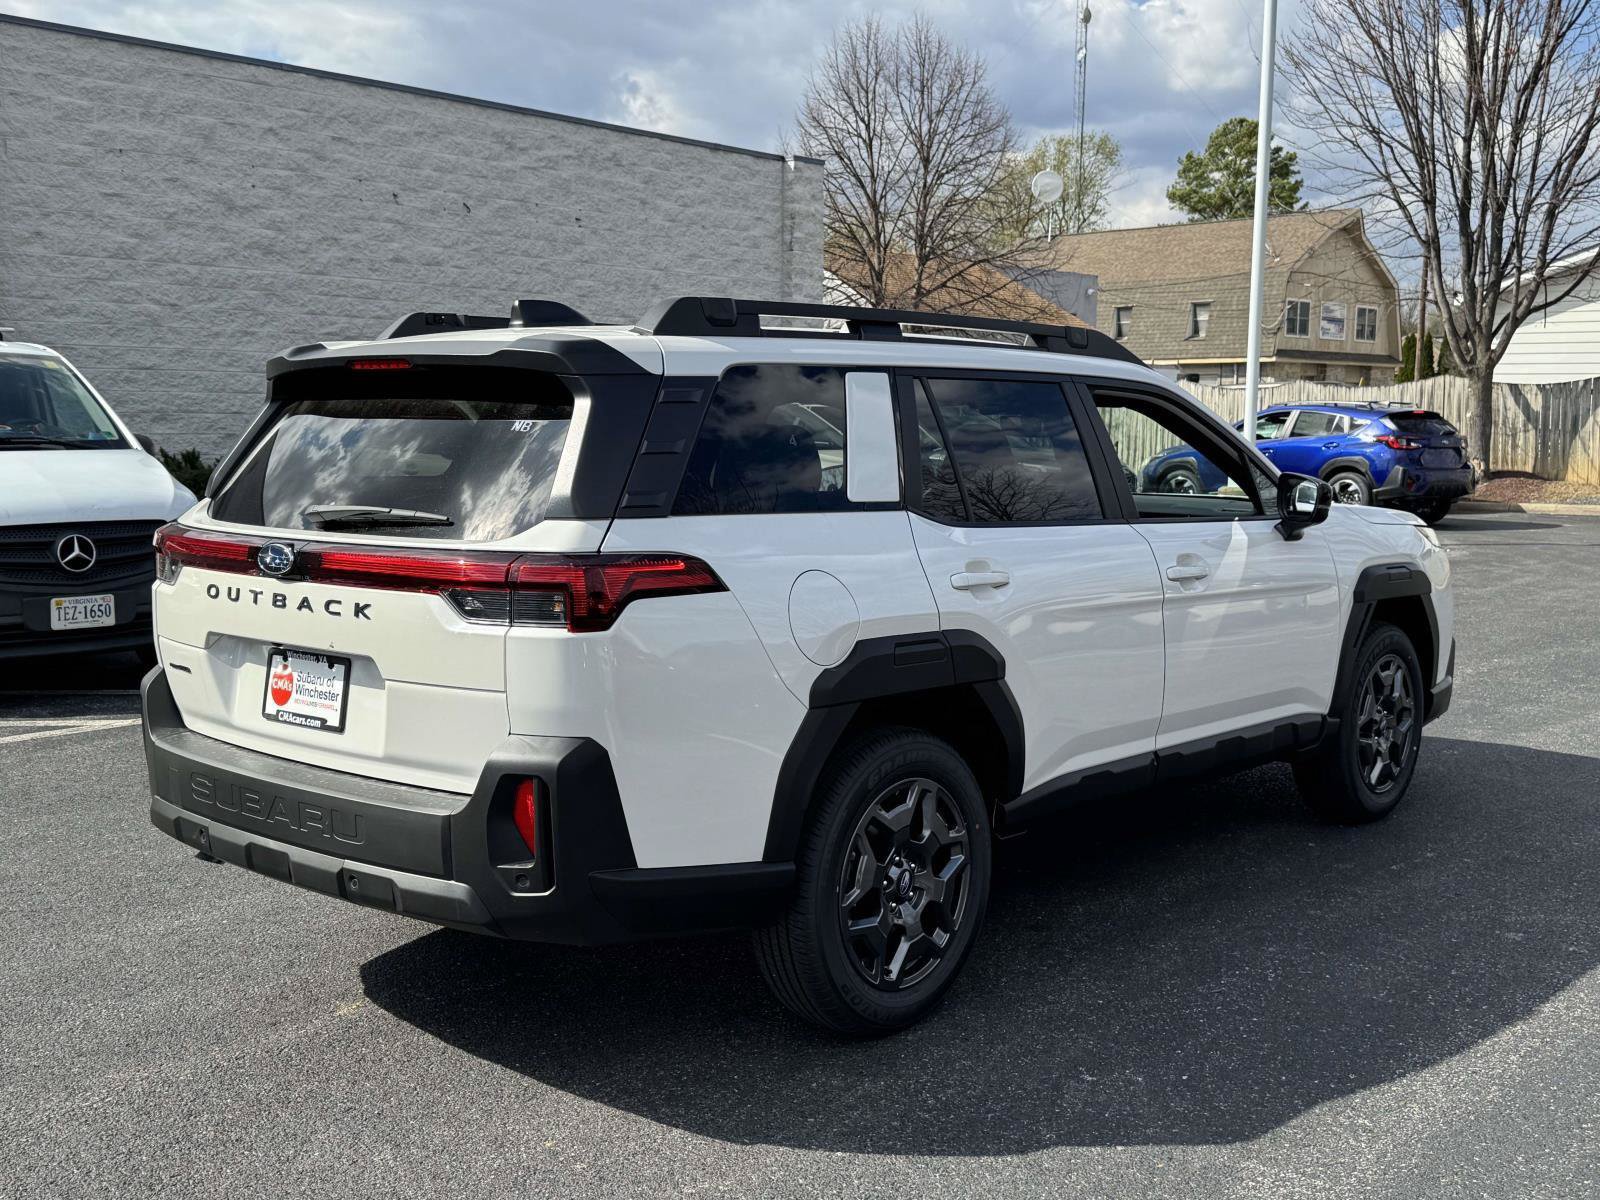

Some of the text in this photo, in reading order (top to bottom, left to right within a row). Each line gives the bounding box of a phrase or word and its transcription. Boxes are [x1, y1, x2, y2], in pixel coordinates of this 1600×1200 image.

[511, 420, 533, 432] NB
[68, 597, 99, 605] VIRGINIA
[206, 583, 372, 621] OUTBACK
[56, 603, 111, 621] TEZ-1650
[318, 655, 328, 664] VA
[296, 671, 336, 688] Subaru of
[295, 683, 340, 703] Winchester
[278, 712, 321, 728] CMAcars.com
[190, 772, 366, 845] SUBARU
